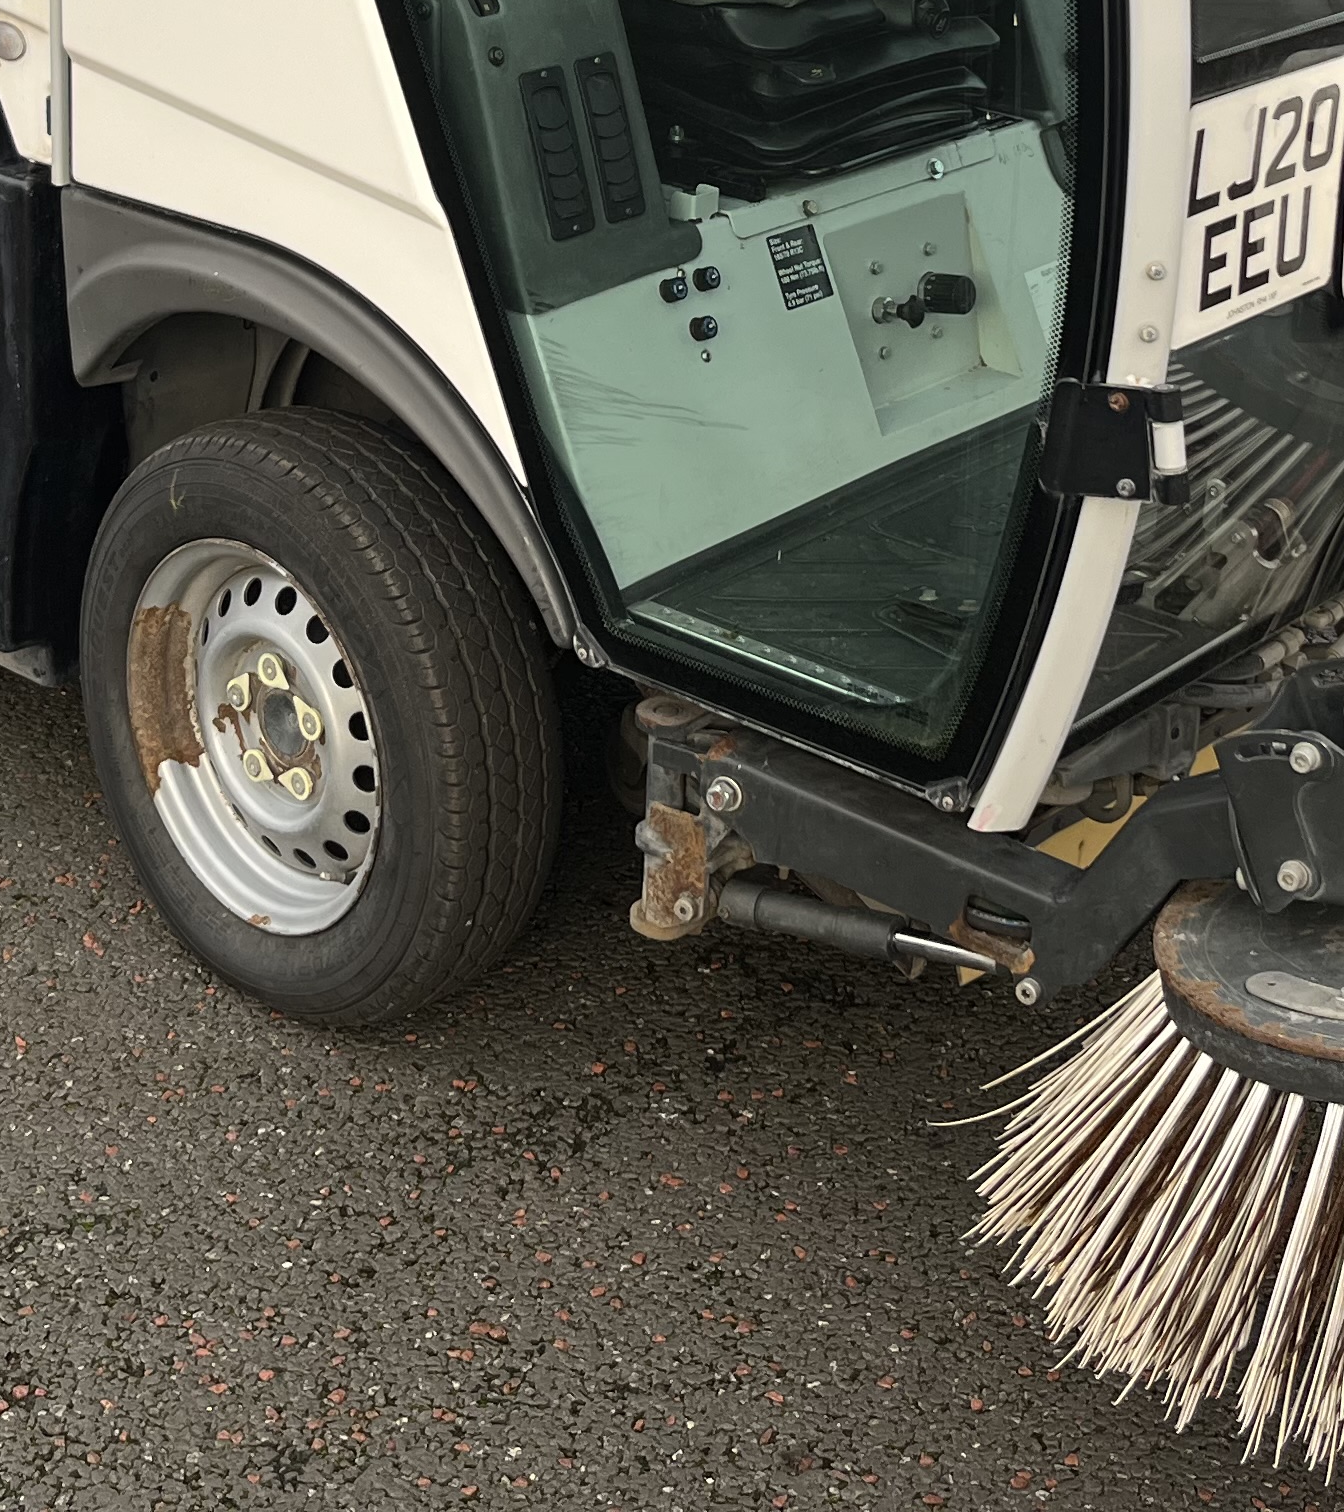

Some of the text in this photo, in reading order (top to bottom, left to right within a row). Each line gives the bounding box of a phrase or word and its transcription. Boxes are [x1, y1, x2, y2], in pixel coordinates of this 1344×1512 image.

[1187, 83, 1340, 219] LJ20
[771, 244, 785, 253] Front
[1199, 185, 1312, 313] EEU
[778, 266, 794, 276] Wheel
[793, 263, 804, 271] Nut
[785, 284, 819, 300] Tyre Pressure
